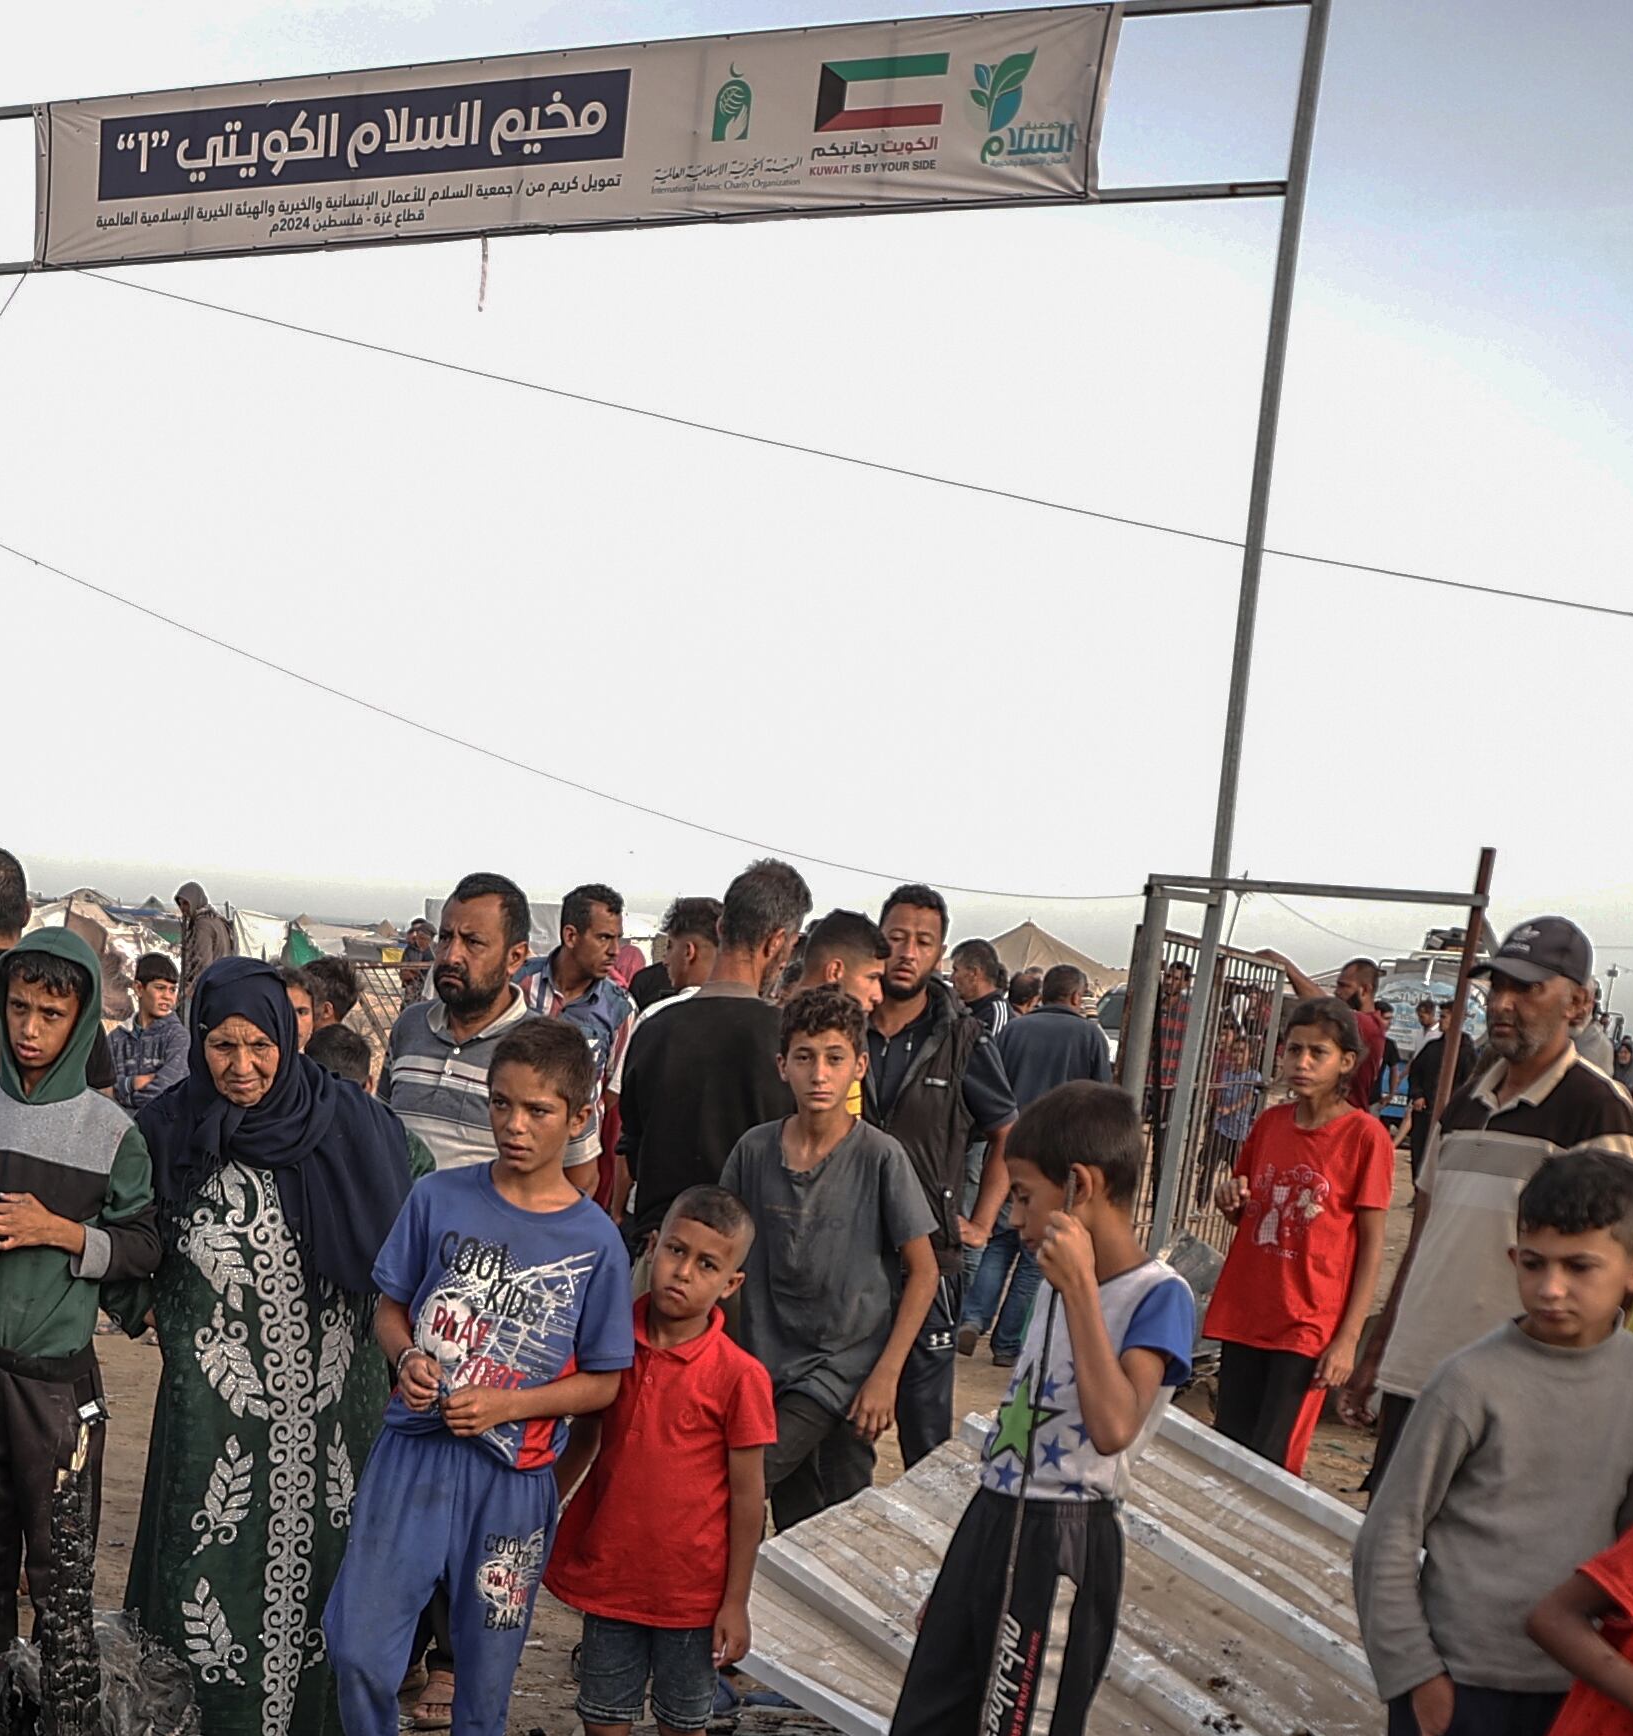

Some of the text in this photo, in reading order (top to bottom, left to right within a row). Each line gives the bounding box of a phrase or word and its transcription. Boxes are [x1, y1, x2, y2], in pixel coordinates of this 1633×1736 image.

[347, 99, 482, 168] السلام
[490, 91, 608, 156] مخيم
[176, 109, 340, 183] الكويتي
[810, 136, 938, 160] الكويت بجانبكم
[980, 123, 1075, 165] السلام
[809, 159, 937, 177] KUWAIT IS BY YOUR SIDE
[650, 177, 801, 194] International Islamic Charity Organization
[96, 173, 622, 228] تمويل كريم من / جمعية السلام للأعمال الإنسانية والخيرية والهيئة الخيرية الإسلامية العالمية
[313, 213, 363, 231] فلسطين
[374, 211, 392, 226] غزة
[395, 209, 425, 228] قطاع
[438, 1230, 510, 1283] COOL
[484, 1280, 543, 1325] KIDS
[484, 1533, 522, 1555] COOL
[485, 1606, 523, 1631] BALL
